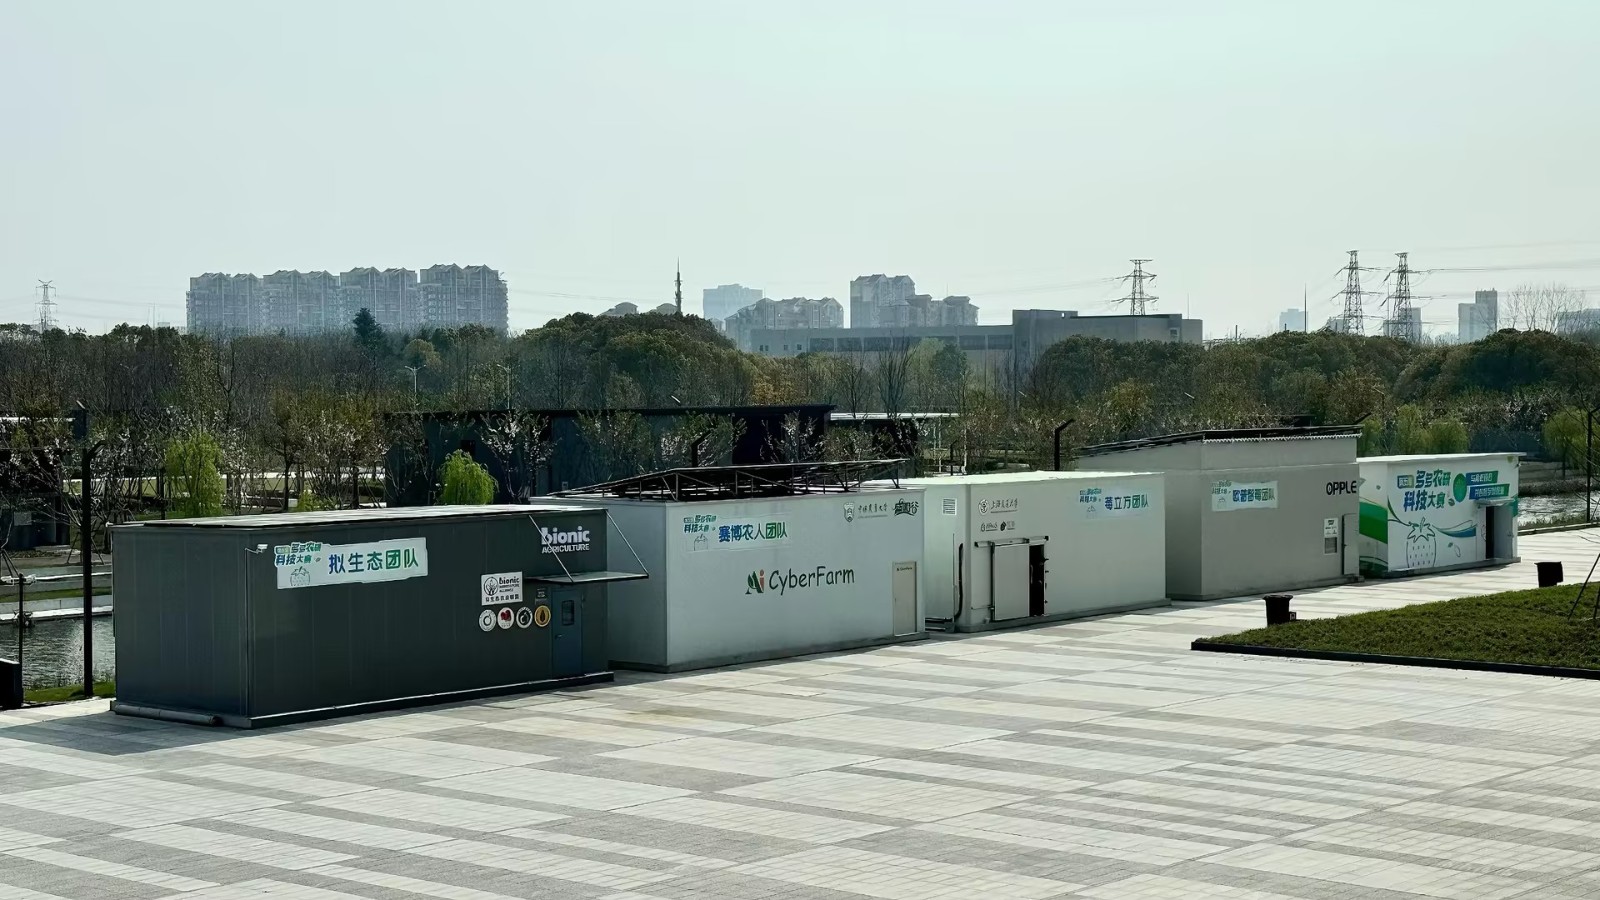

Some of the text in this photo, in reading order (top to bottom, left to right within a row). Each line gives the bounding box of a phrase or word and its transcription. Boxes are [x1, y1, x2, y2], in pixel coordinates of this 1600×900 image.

[1326, 480, 1357, 496] OPPLE
[1415, 469, 1451, 488] 多多农研
[1104, 493, 1149, 510] 莓立方团队
[1403, 489, 1445, 512] 科技大赛
[540, 525, 591, 545] bionic
[718, 521, 788, 543] 赛博农人团队
[541, 543, 590, 554] AGRICULTURE
[328, 547, 419, 575] 拟生态团队
[498, 575, 520, 585] bionic
[768, 565, 856, 596] CyberFarm
